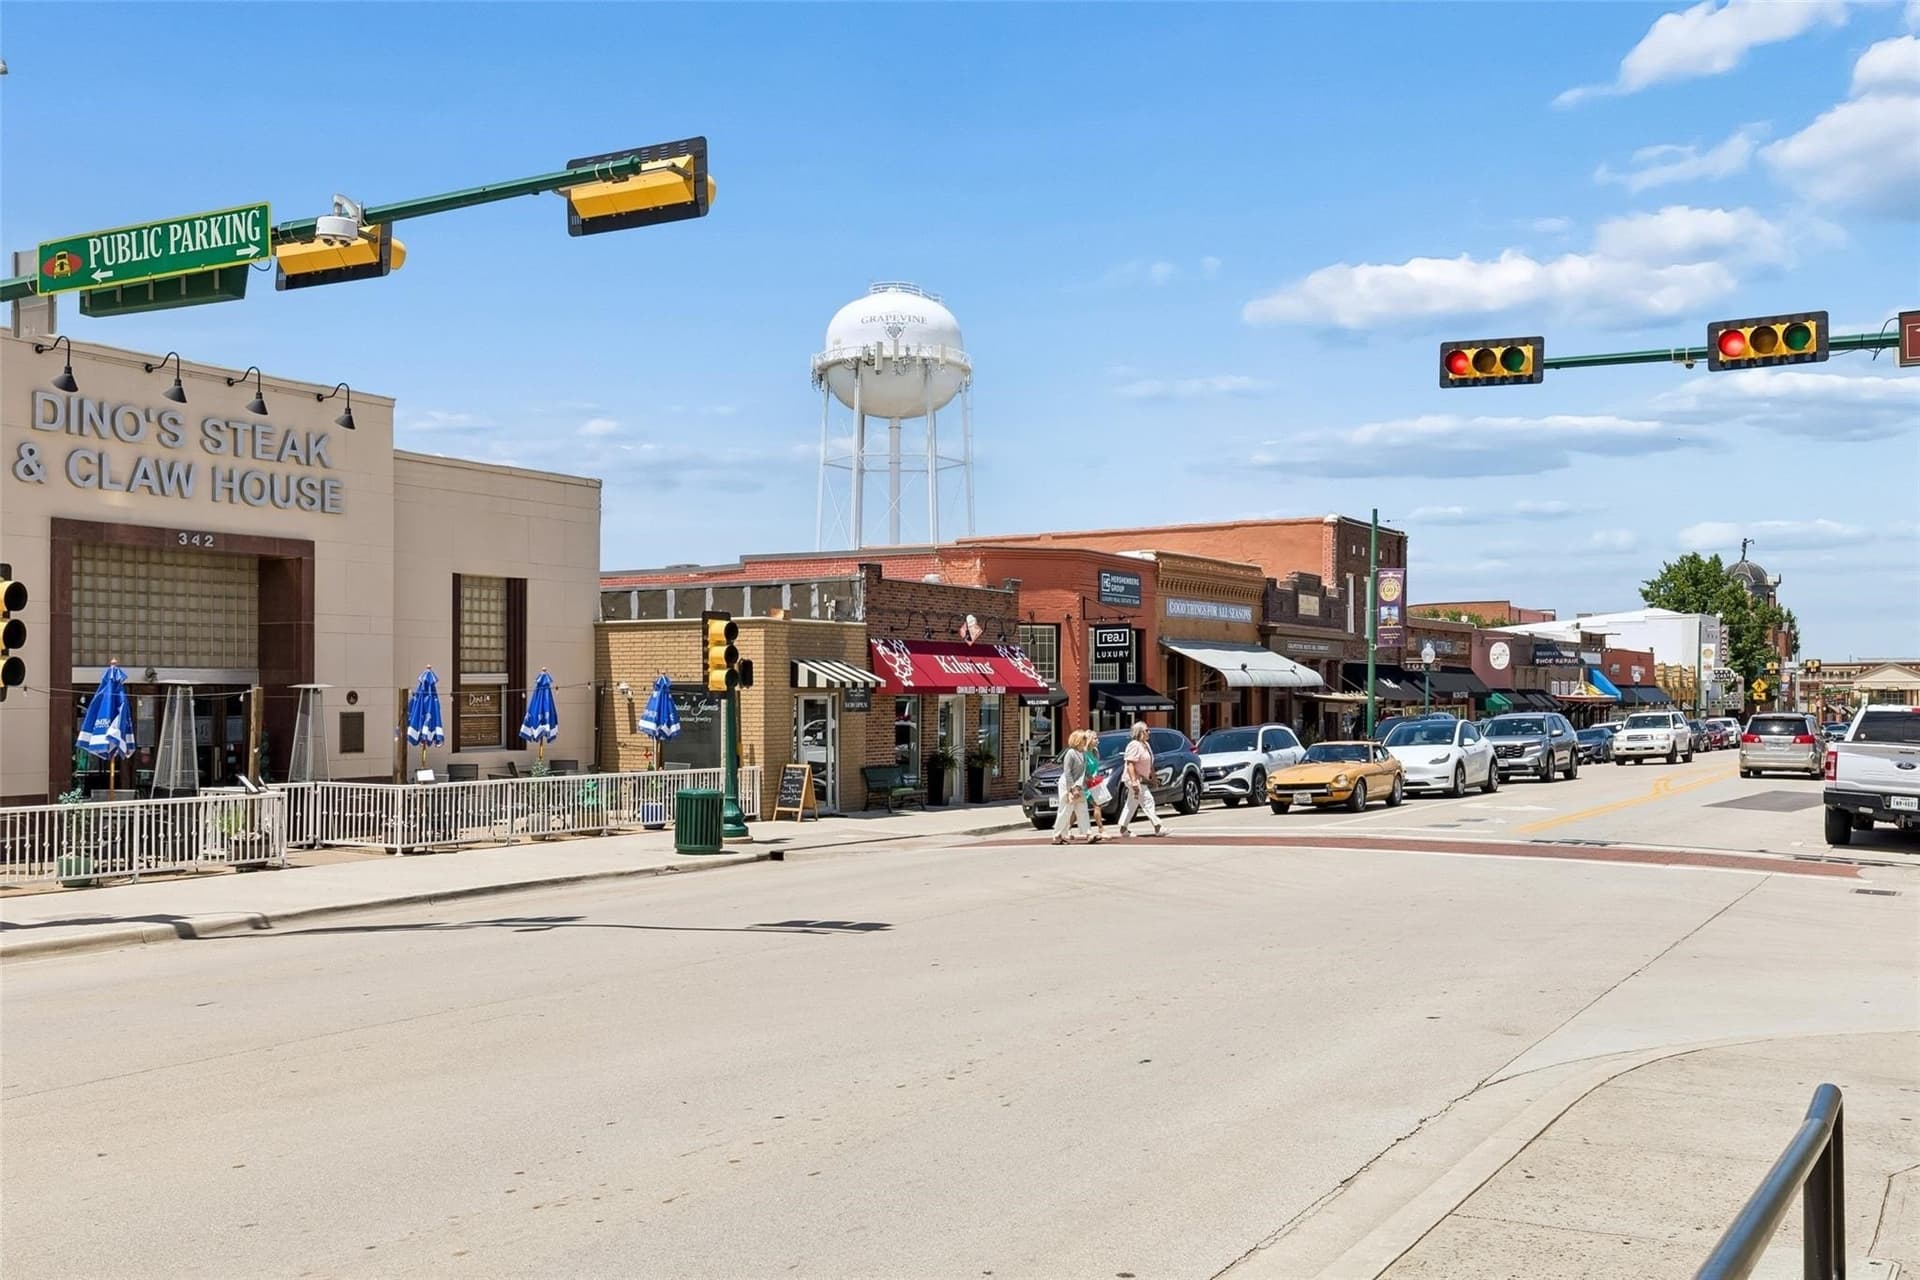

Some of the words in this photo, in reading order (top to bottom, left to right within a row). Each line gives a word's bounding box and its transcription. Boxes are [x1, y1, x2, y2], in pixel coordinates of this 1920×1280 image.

[88, 227, 162, 268] PUBLIC
[169, 209, 261, 255] PARKING
[860, 314, 928, 325] GRAPEVINE
[32, 391, 186, 449] DINO'S
[200, 417, 333, 468] STEAK
[13, 441, 46, 484] &
[65, 449, 196, 499] CLAW
[211, 465, 345, 514] HOUSE
[178, 532, 215, 547] 342
[1110, 584, 1125, 593] GROUP
[1169, 599, 1186, 614] GOOD
[1219, 606, 1229, 618] ALL
[1229, 607, 1252, 621] SEASONS
[1102, 632, 1124, 642] real
[1096, 650, 1129, 658] LUXURY
[1555, 657, 1579, 665] REPAIR
[933, 654, 995, 675] Kilwins
